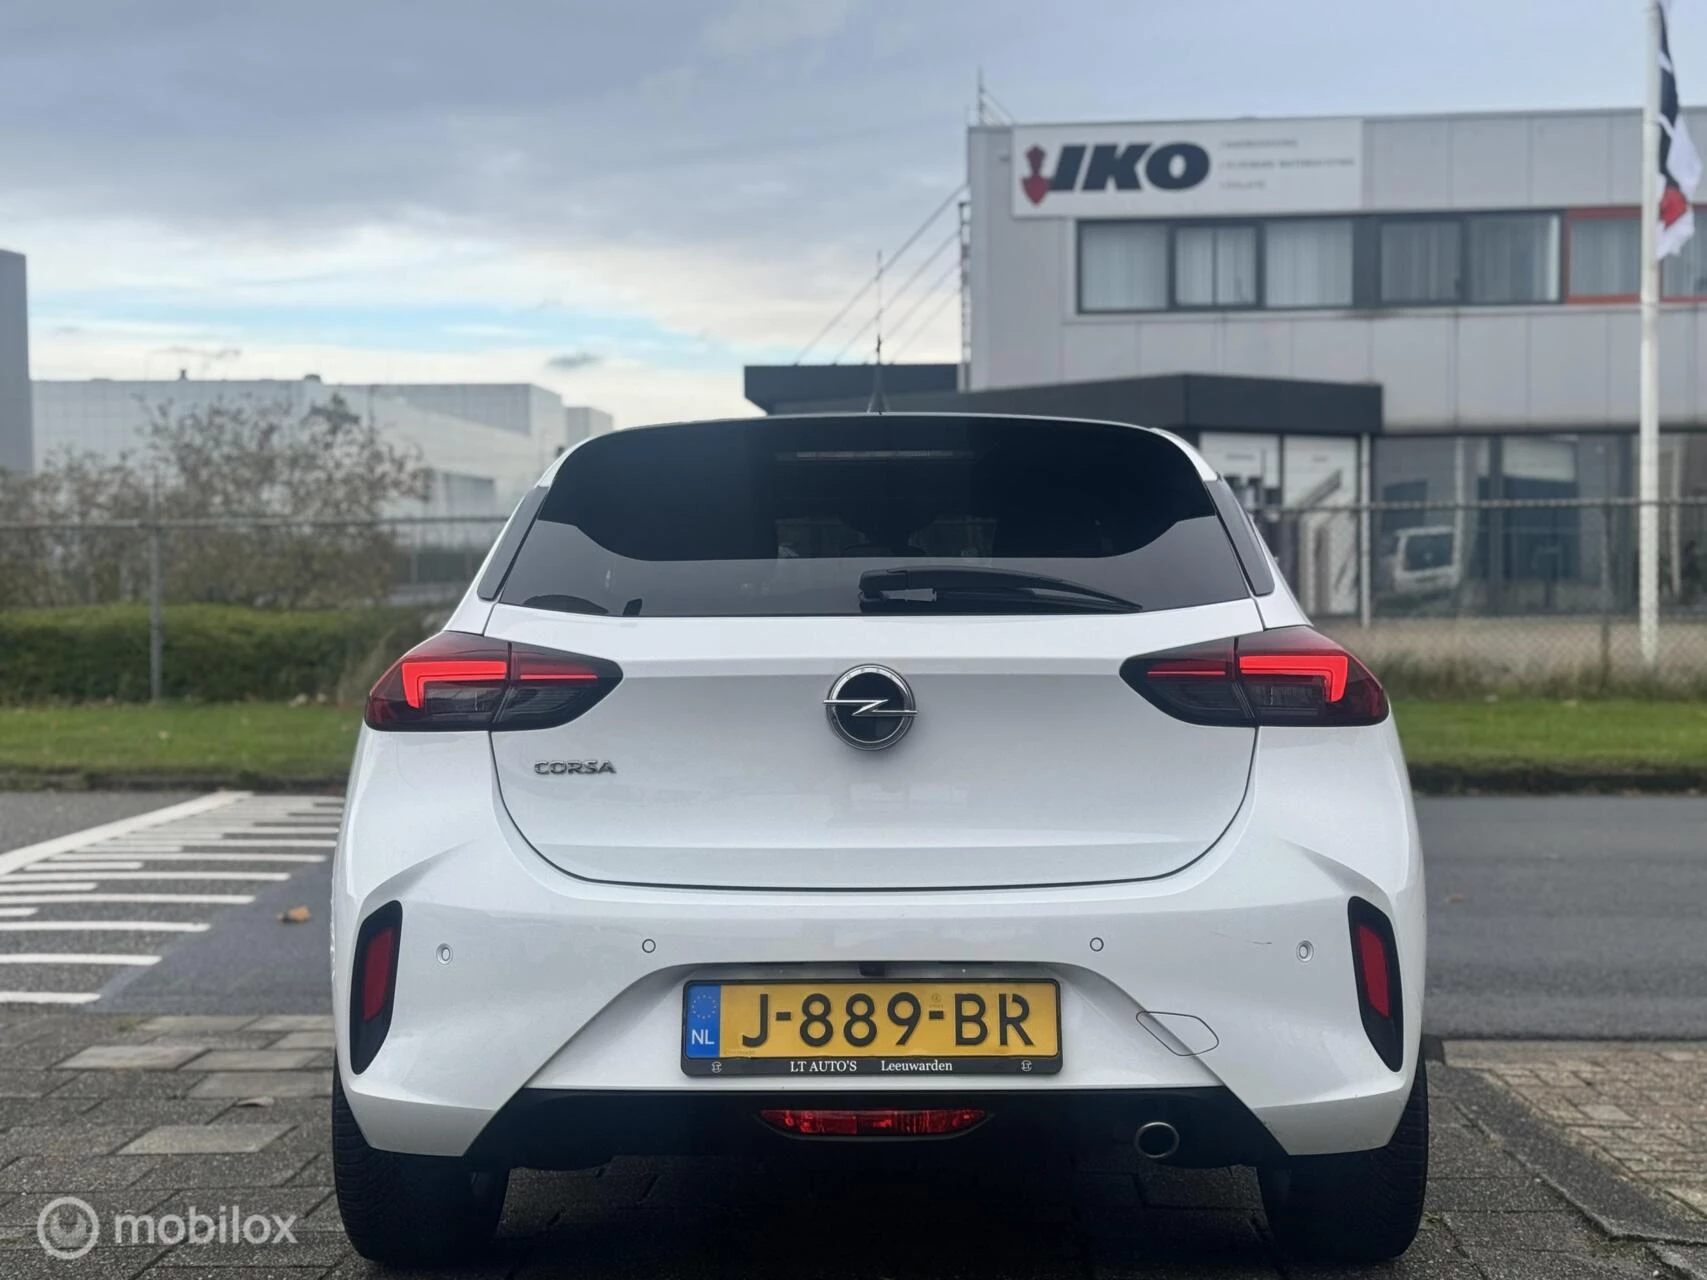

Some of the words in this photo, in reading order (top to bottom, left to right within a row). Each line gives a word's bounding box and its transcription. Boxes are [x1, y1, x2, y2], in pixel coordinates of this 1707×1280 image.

[1049, 142, 1211, 191] IKO
[534, 761, 617, 775] CORSA
[741, 992, 1036, 1048] J-889-BR
[691, 1029, 715, 1045] NL
[790, 1061, 808, 1073] LT
[809, 1061, 857, 1072] AUTO'S
[881, 1060, 953, 1071] Leeuwarden
